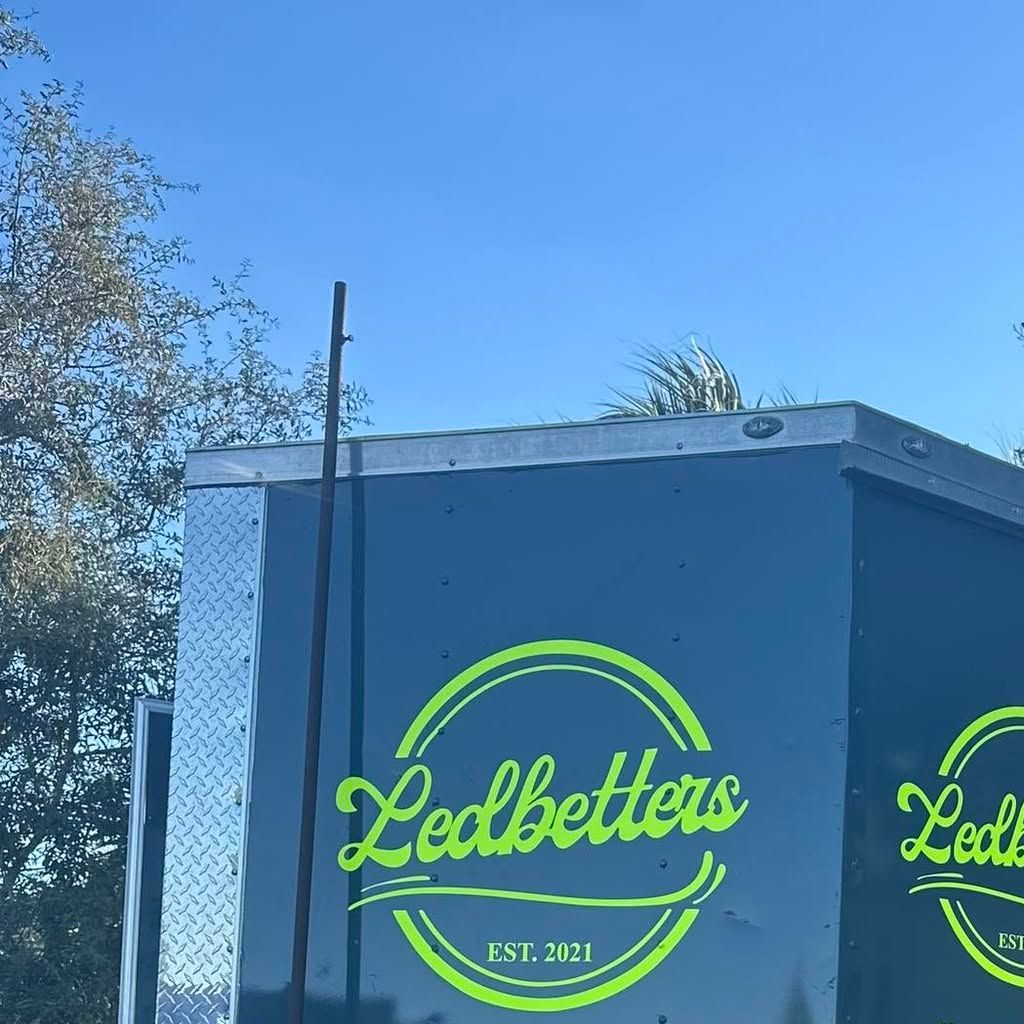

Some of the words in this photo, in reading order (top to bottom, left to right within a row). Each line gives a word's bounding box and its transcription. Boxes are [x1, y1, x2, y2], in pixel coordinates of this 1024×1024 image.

[336, 748, 749, 871] Ledbetters
[487, 942, 537, 962] EST.
[545, 942, 592, 963] 2021
